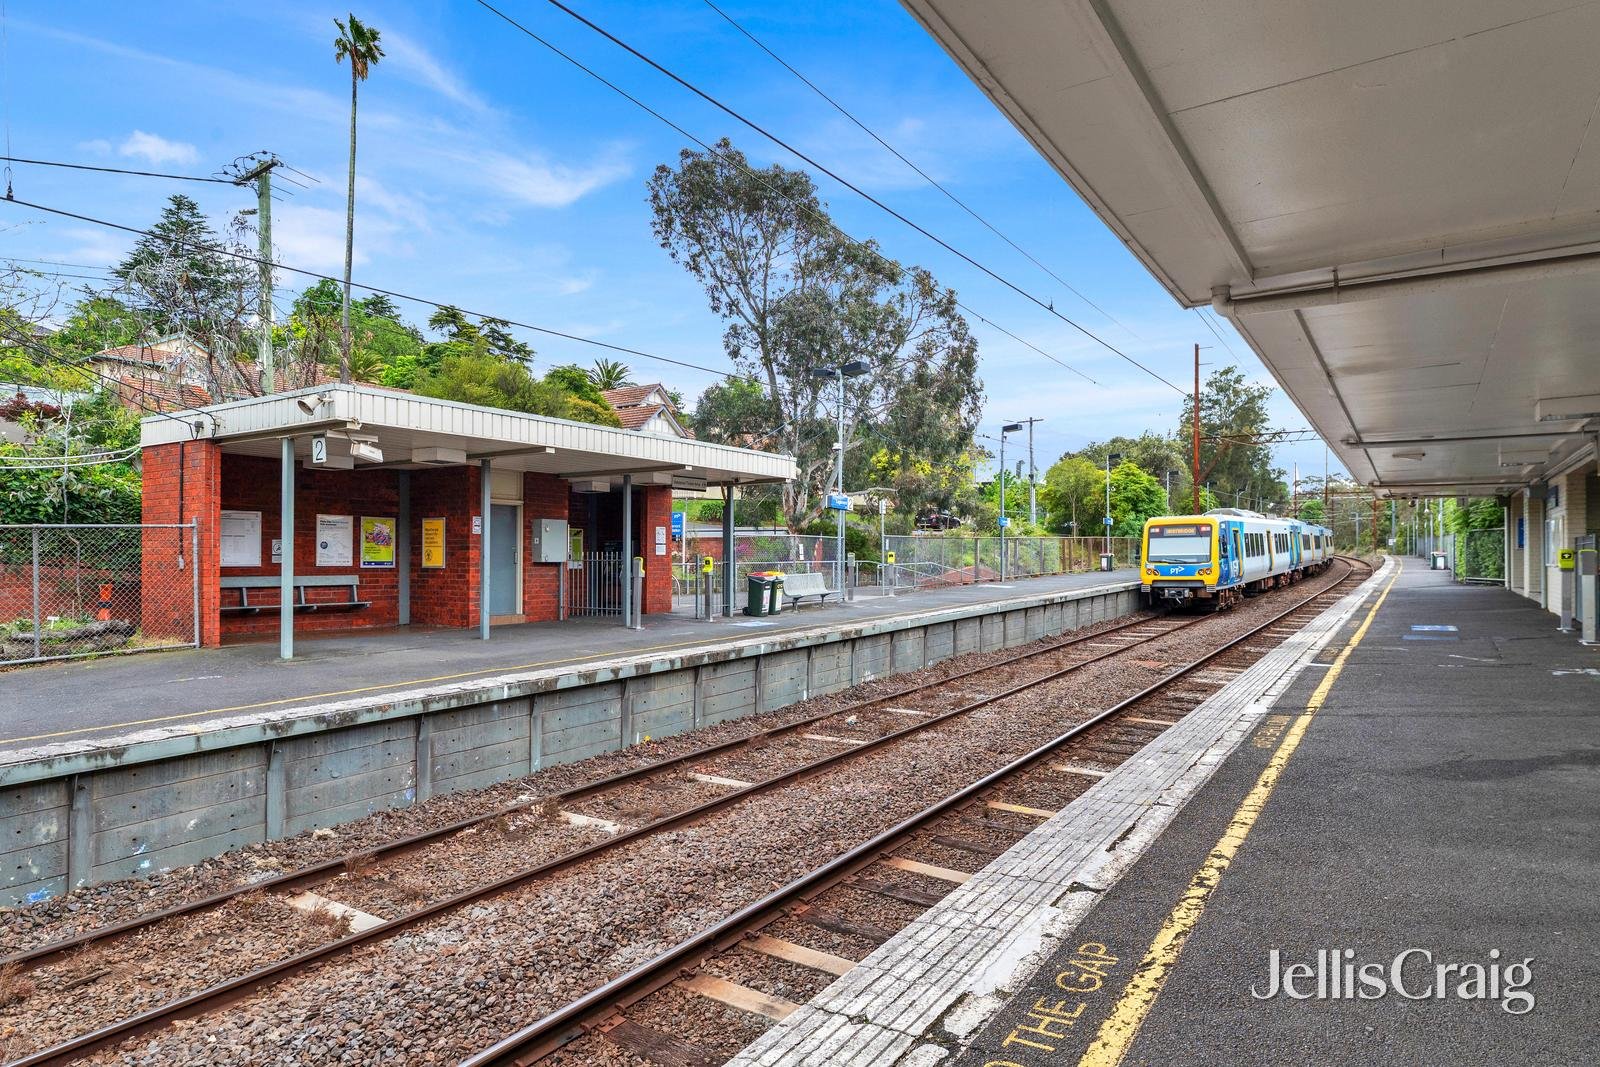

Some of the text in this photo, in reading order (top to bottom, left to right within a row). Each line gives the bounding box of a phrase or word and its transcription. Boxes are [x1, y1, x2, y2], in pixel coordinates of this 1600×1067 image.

[316, 440, 323, 460] 2
[848, 498, 852, 509] 2
[1001, 995, 1087, 1051] THE
[1055, 942, 1119, 993] GAP
